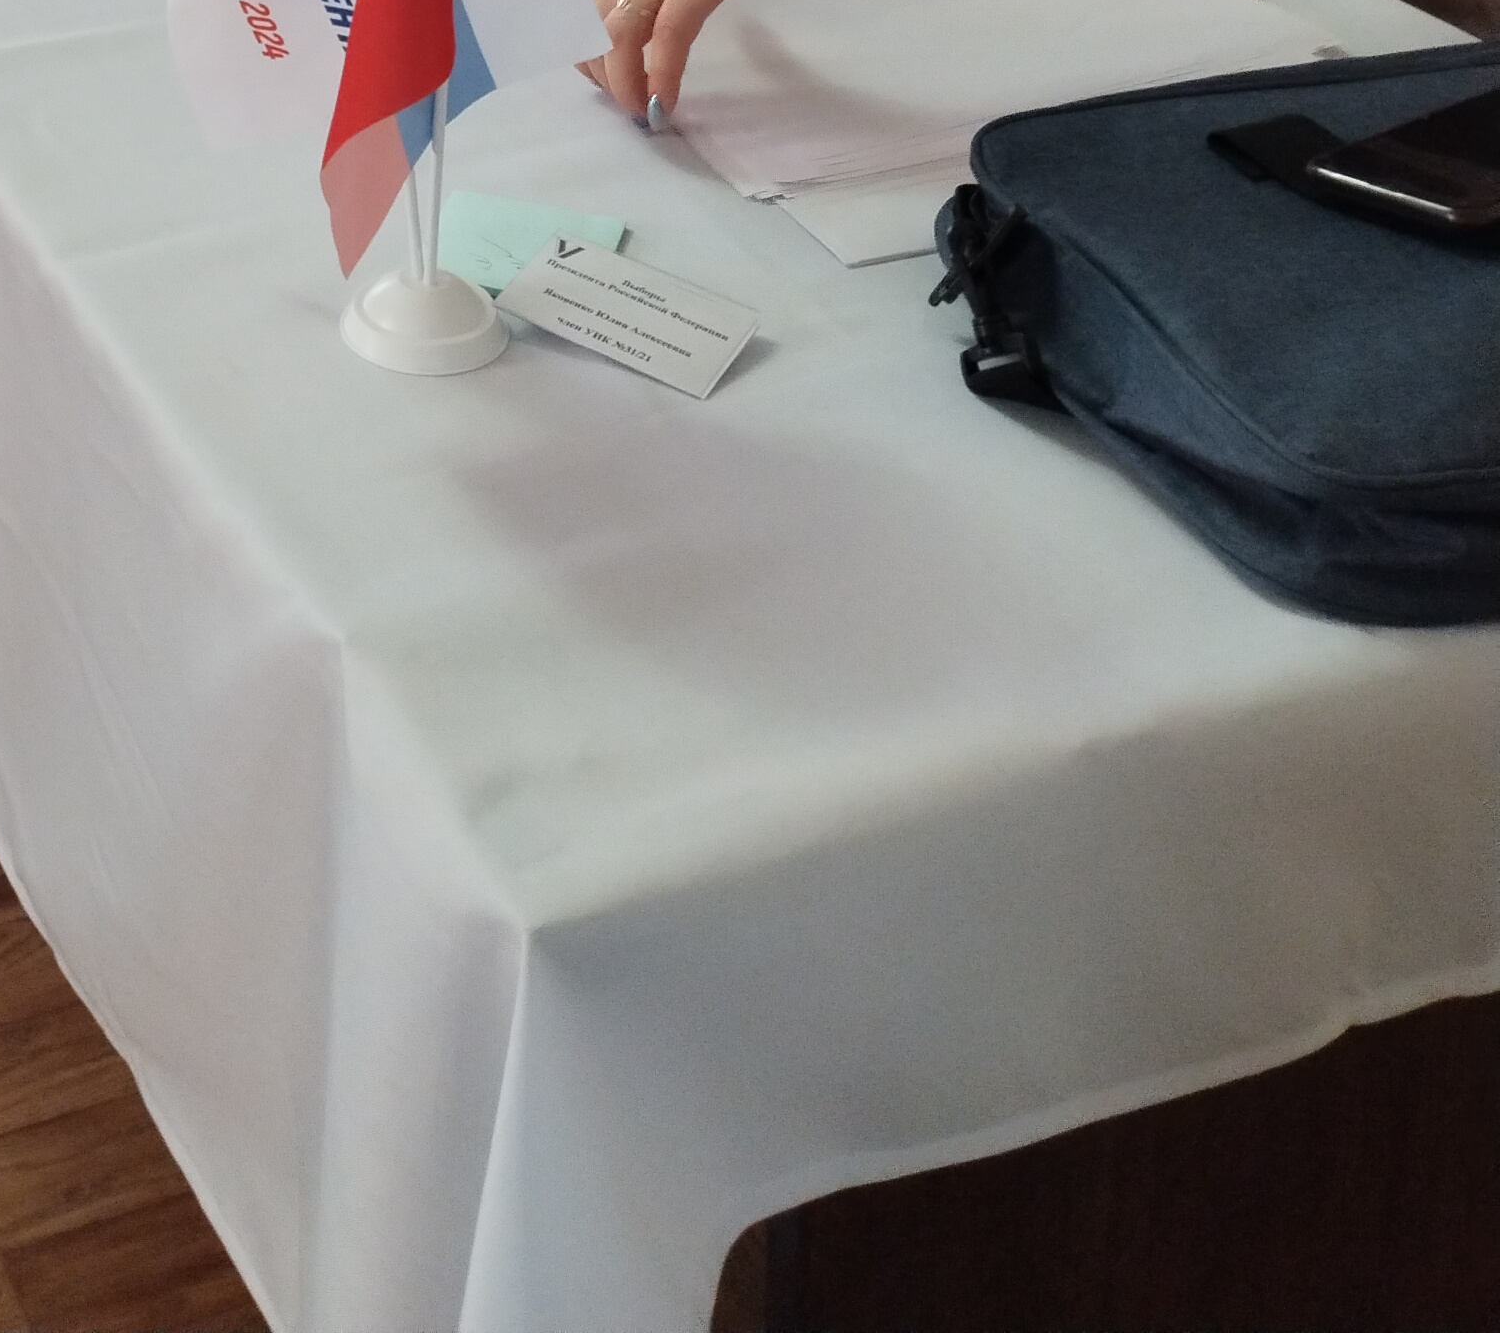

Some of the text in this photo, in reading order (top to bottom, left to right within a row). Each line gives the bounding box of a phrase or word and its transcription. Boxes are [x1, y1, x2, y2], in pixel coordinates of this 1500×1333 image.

[239, 0, 290, 60] 2024
[547, 258, 729, 341] Президента Российской Федерации
[621, 279, 667, 302] Выборы
[557, 316, 582, 332] член
[584, 327, 613, 346] УИК
[596, 310, 629, 329] Юлия
[630, 326, 692, 358] Алексеевна
